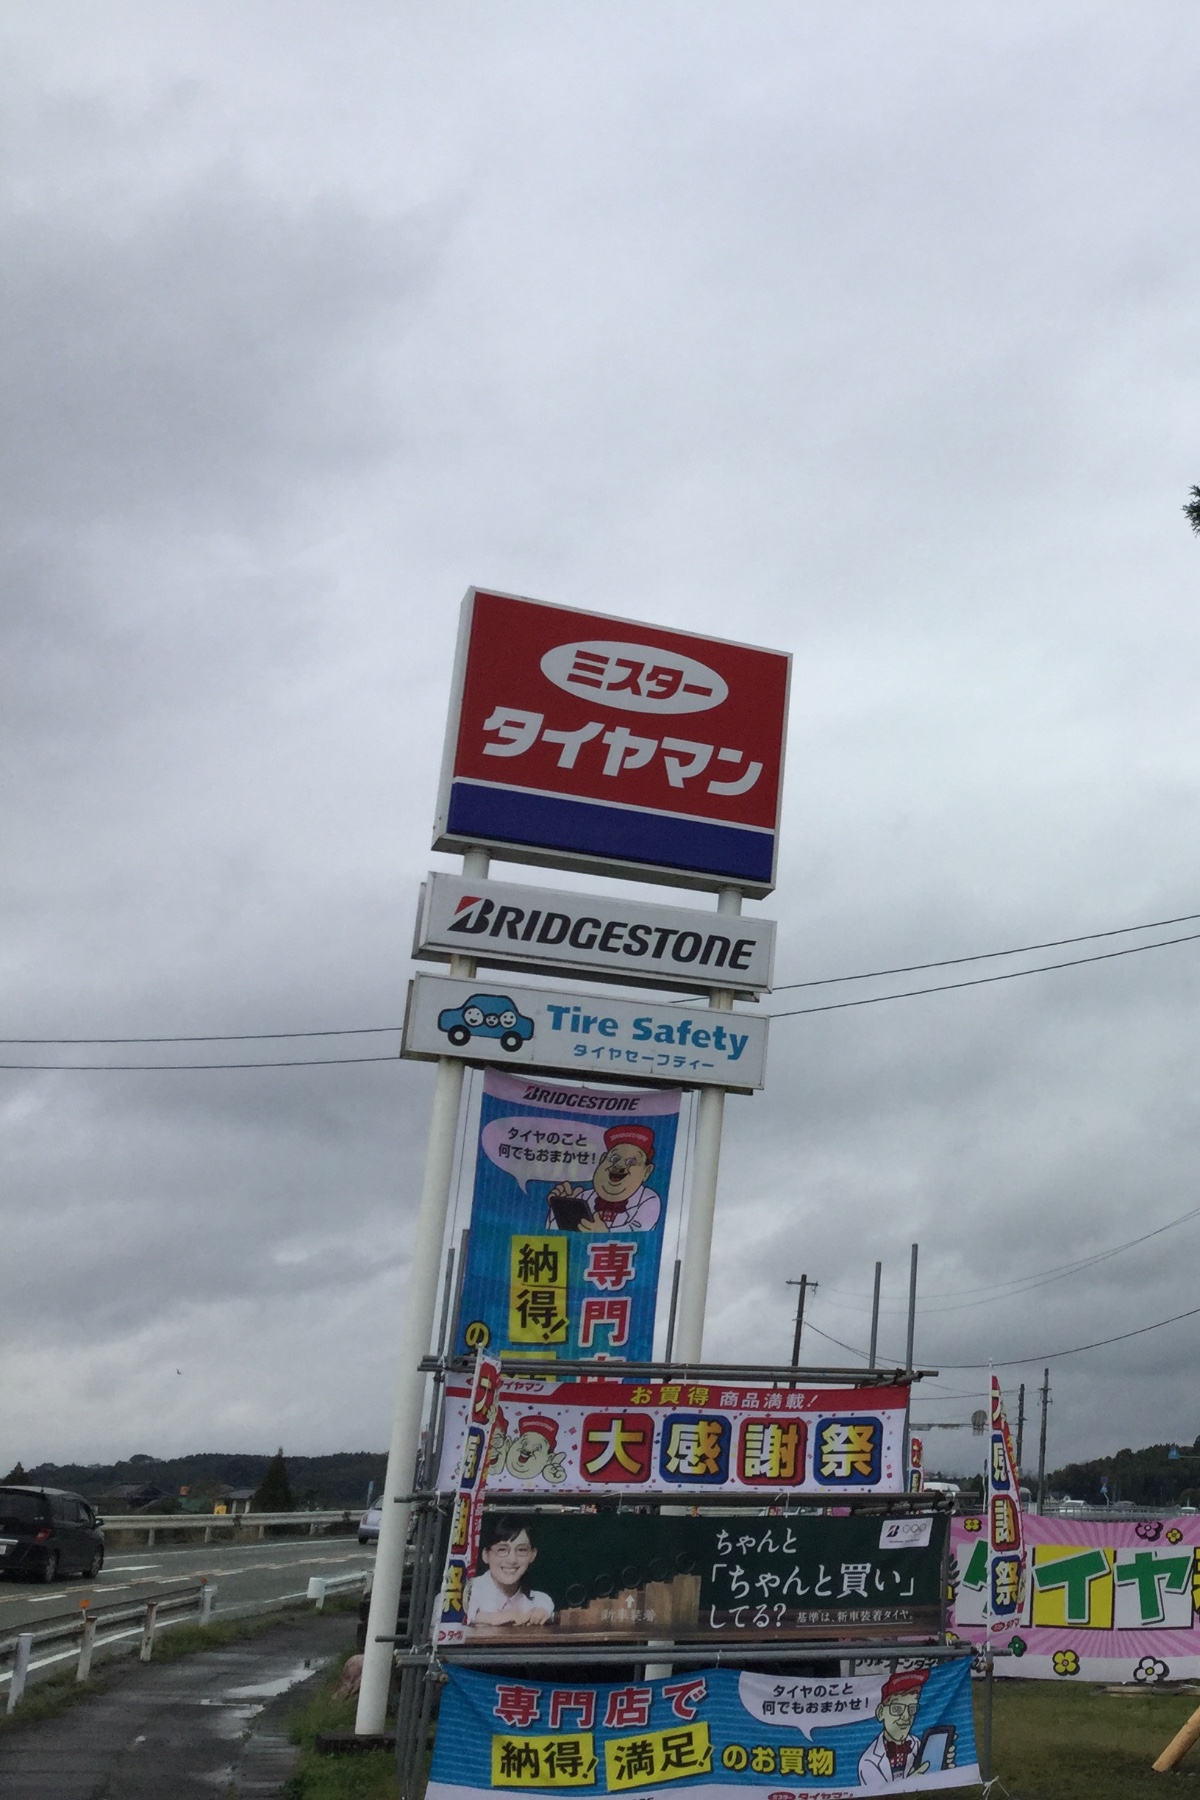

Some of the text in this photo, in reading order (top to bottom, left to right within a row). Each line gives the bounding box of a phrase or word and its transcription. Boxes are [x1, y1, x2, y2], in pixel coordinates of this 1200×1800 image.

[567, 650, 713, 699] ミスター
[482, 705, 763, 796] タイヤマン
[447, 895, 756, 970] BRIDGESTONE
[547, 1004, 749, 1060] Tire Safety
[574, 1044, 714, 1070] タイヤセーフティー
[523, 1086, 640, 1111] BRIDGESTONE
[508, 1127, 587, 1146] タイヤのこと
[498, 1381, 544, 1392] イヤマン
[630, 1386, 709, 1406] お買得
[586, 1418, 874, 1478] 大感謝祭
[716, 1527, 797, 1555] ちゃんと
[711, 1563, 914, 1599] 「ちゃんと買い」
[710, 1603, 786, 1629] してる?
[493, 1677, 706, 1728] 専門店で
[773, 1683, 853, 1699] タイヤのこと
[722, 1744, 835, 1777] のお買物
